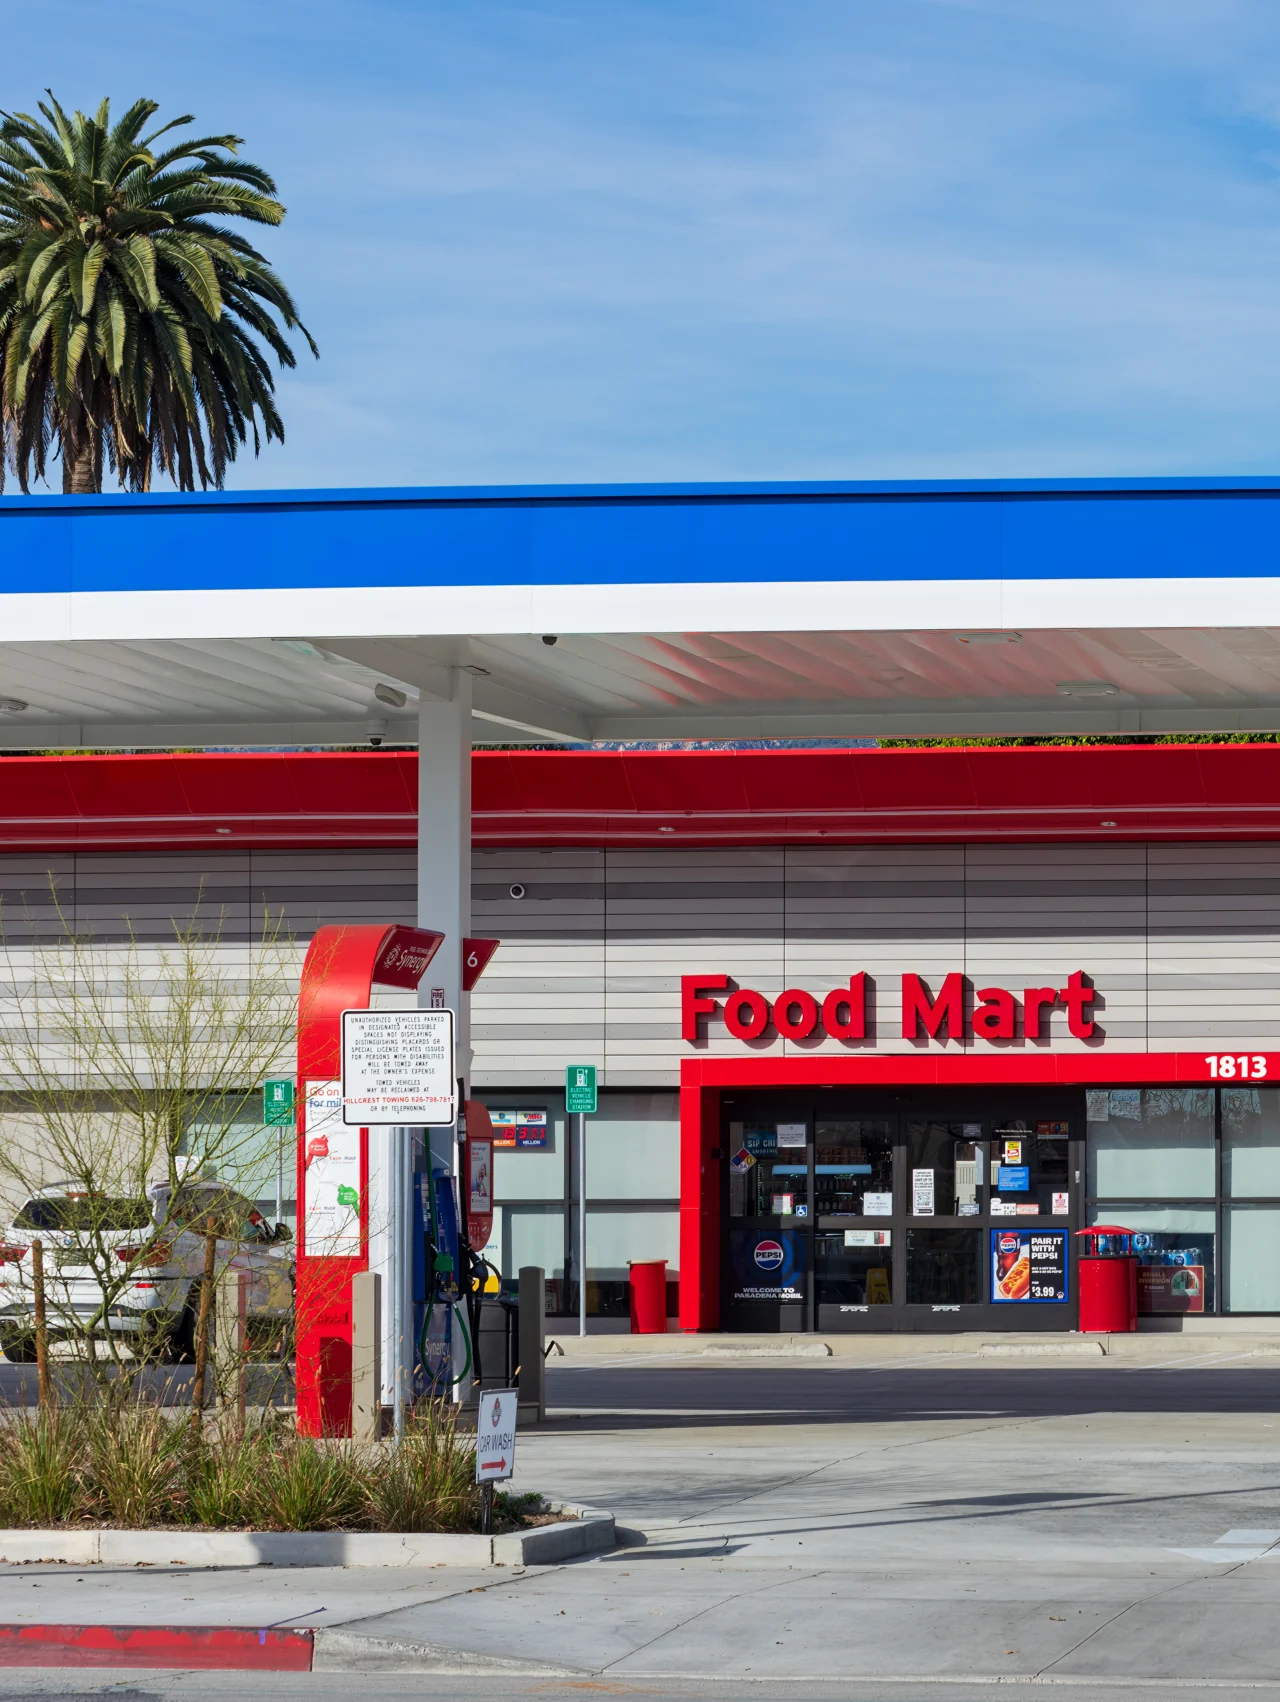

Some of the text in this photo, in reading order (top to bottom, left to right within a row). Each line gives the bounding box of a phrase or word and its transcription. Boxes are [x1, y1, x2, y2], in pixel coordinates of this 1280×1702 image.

[467, 951, 478, 968] 6
[681, 970, 1095, 1040] Food Mart
[1204, 1056, 1267, 1078] 1813
[310, 1087, 324, 1096] Go
[310, 1098, 341, 1107] for mil
[1032, 1286, 1054, 1297] $3.99
[480, 1433, 513, 1453] CAR WASH
